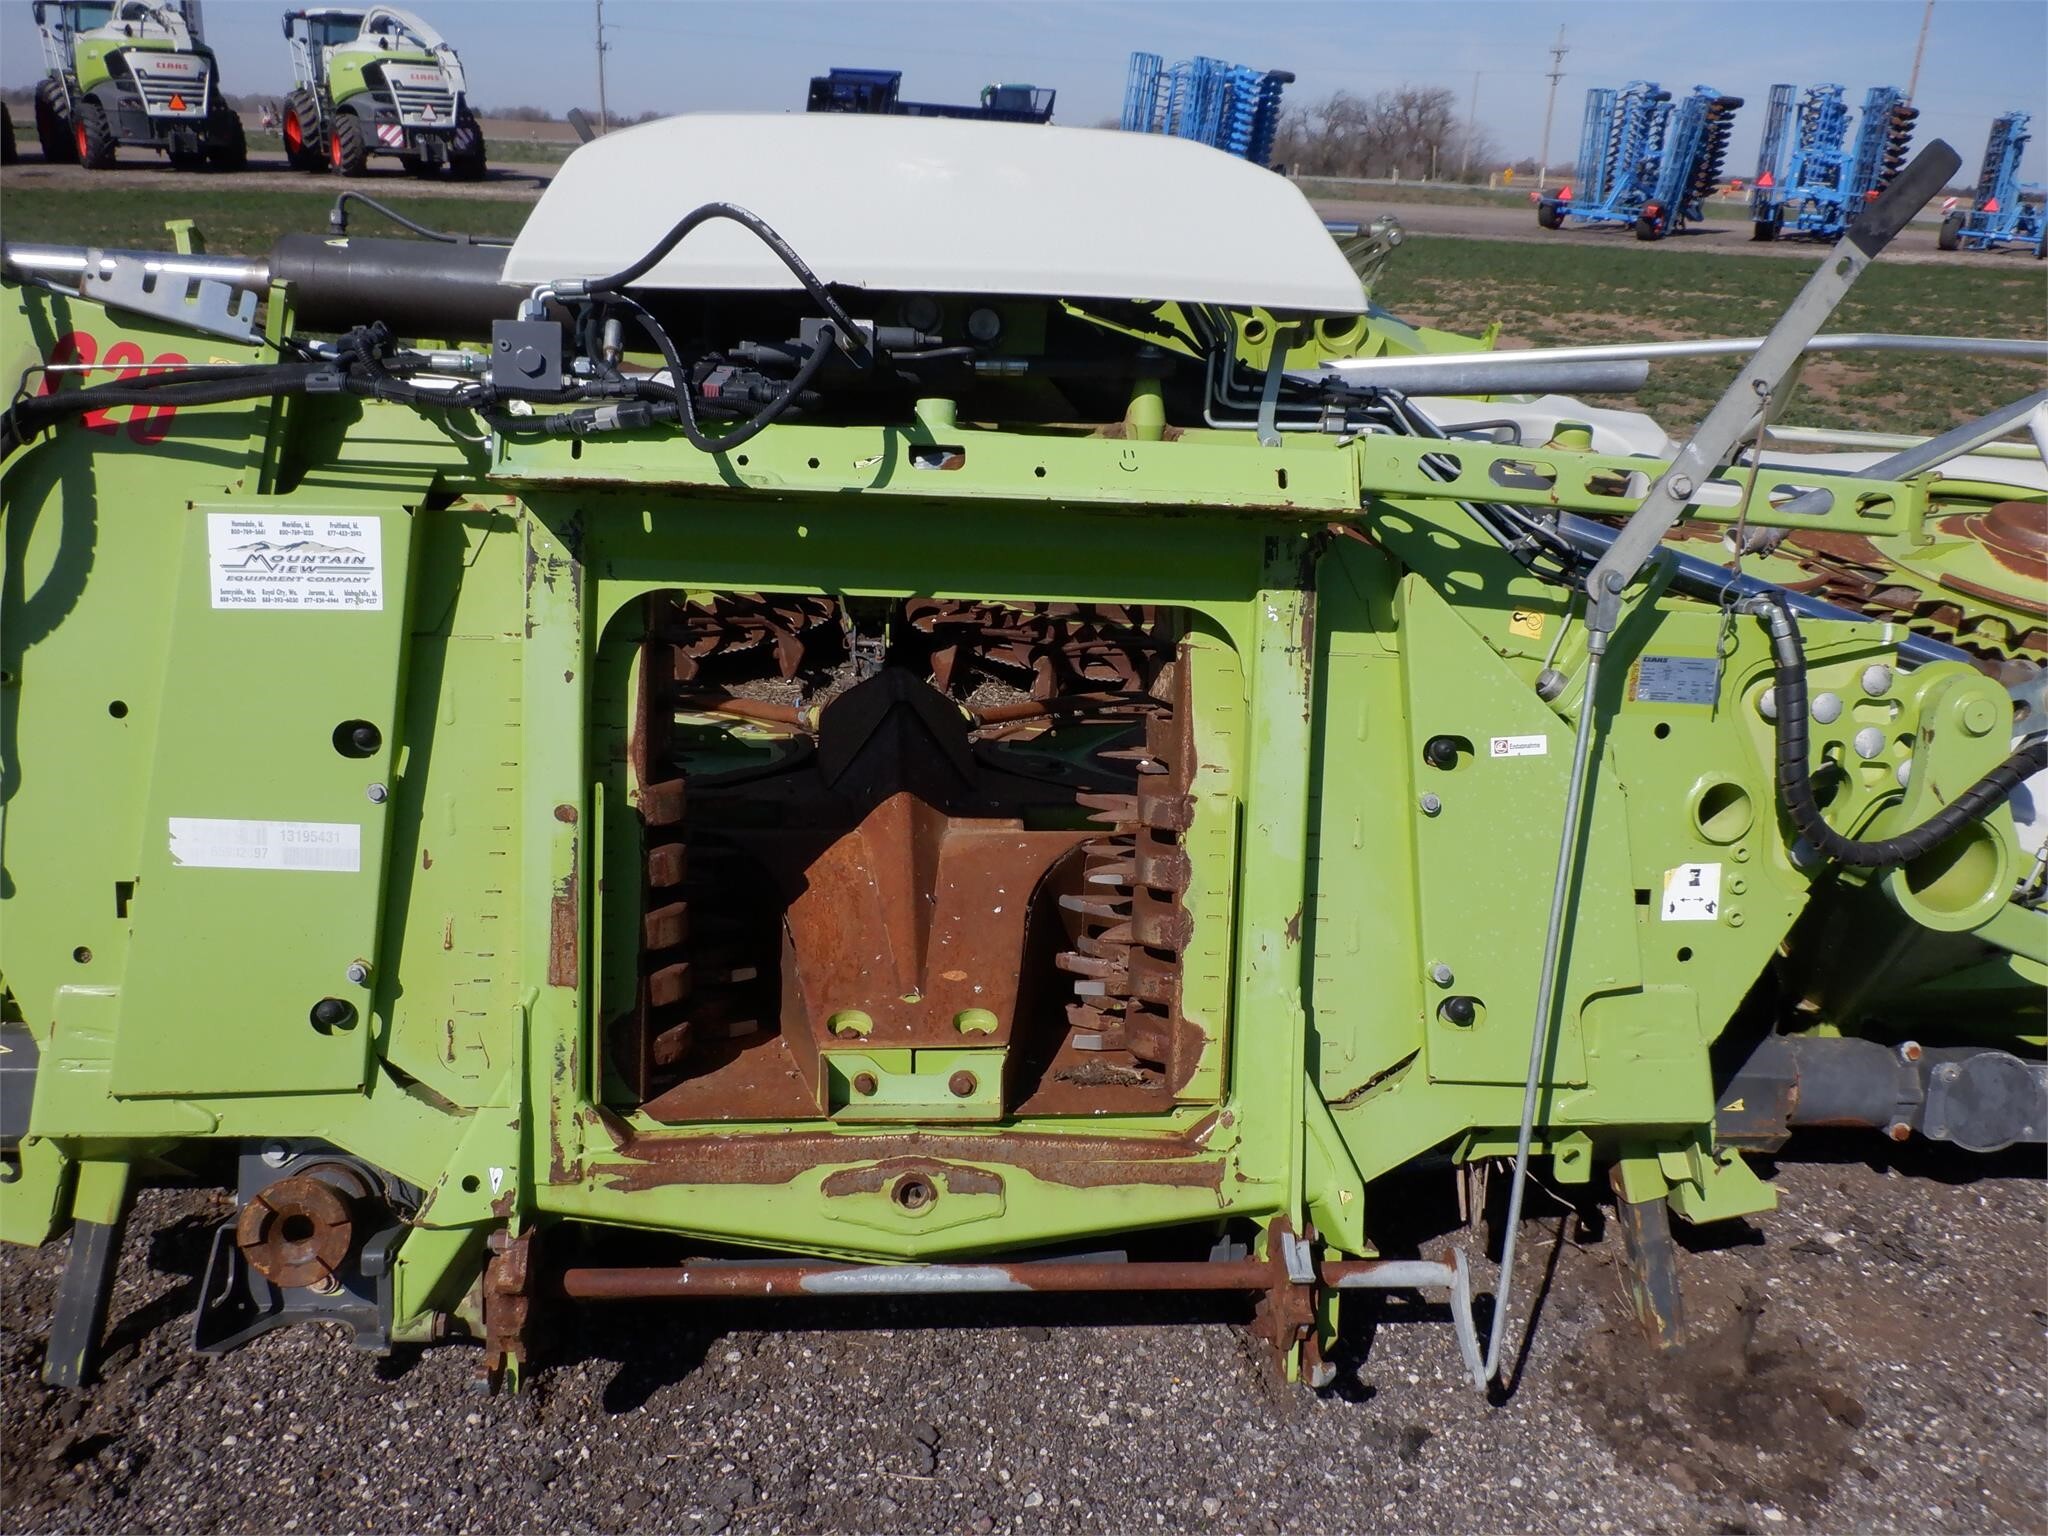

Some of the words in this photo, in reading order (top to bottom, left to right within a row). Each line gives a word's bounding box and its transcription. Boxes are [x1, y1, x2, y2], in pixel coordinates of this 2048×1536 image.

[156, 61, 189, 71] CLAAS
[410, 73, 440, 81] CLAAS
[246, 554, 366, 566] MOUNTAIN
[265, 563, 318, 573] VIEW
[280, 829, 341, 844] 13195431
